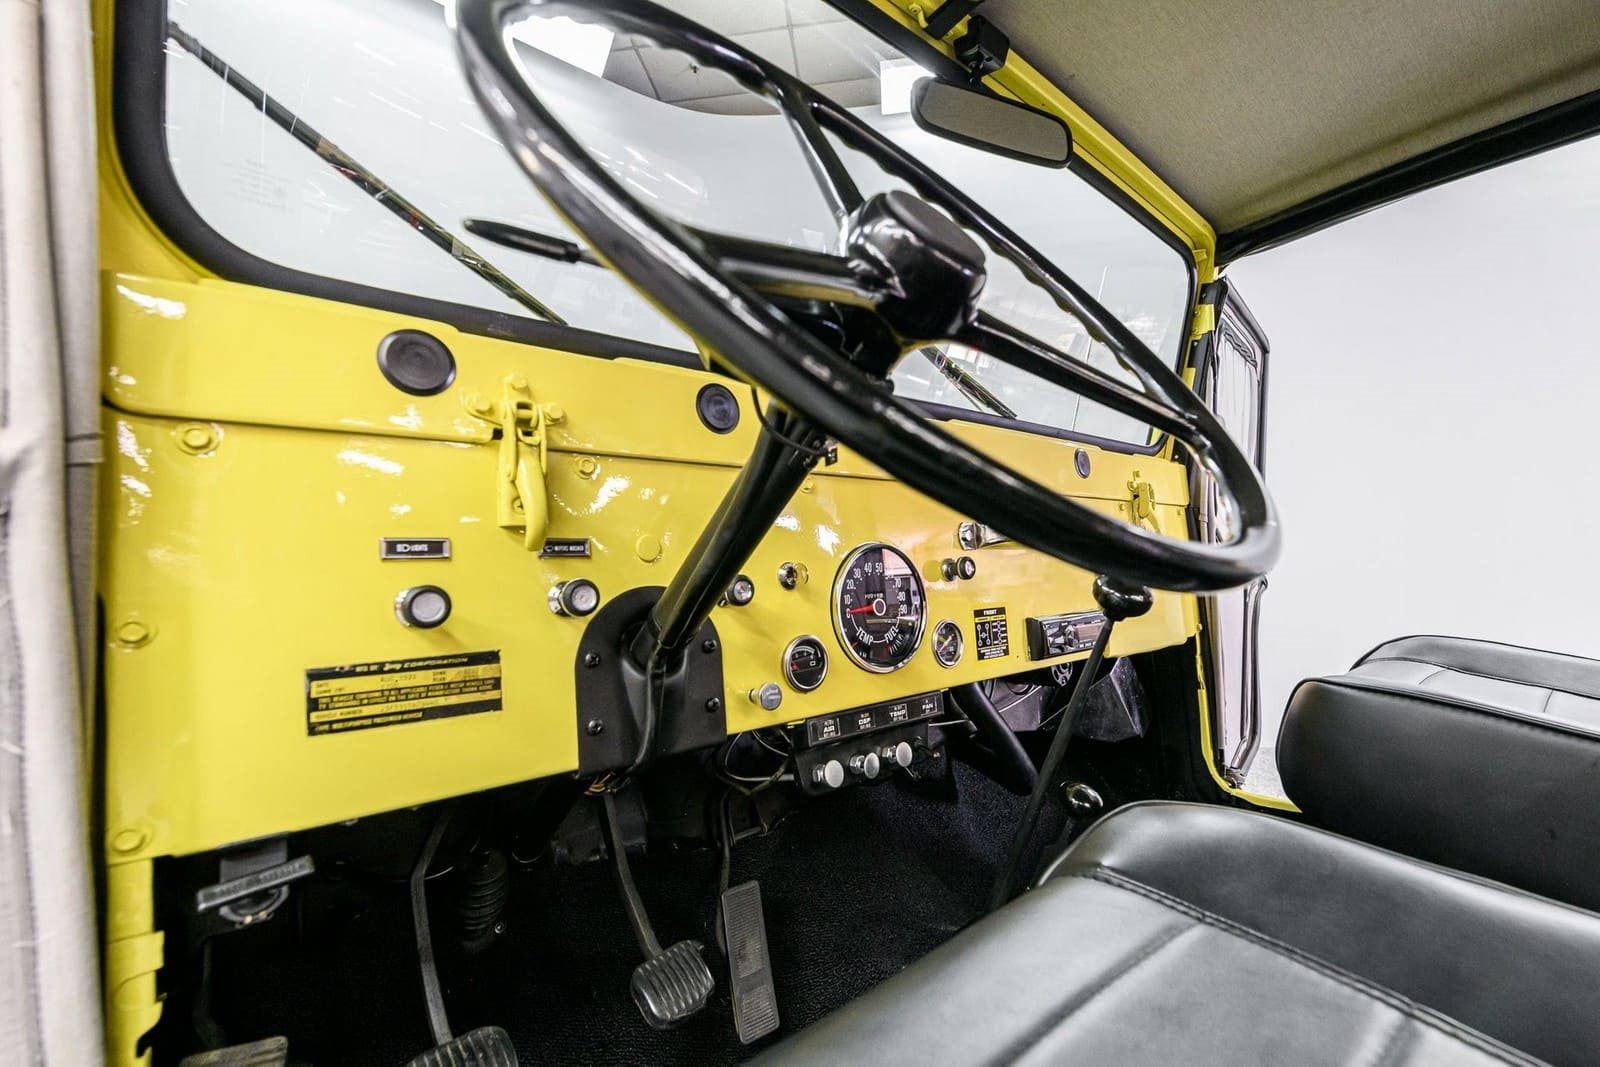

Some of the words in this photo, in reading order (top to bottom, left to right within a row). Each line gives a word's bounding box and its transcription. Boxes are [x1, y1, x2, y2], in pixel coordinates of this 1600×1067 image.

[864, 562, 872, 573] 40
[875, 562, 883, 573] 50
[853, 568, 861, 578] 30
[846, 579, 854, 590] 20
[844, 595, 851, 605] 10
[855, 626, 874, 646] TEMP
[884, 624, 899, 644] FUEL
[922, 702, 934, 710] FAN
[889, 709, 906, 718] TEMP
[823, 725, 835, 733] AIR
